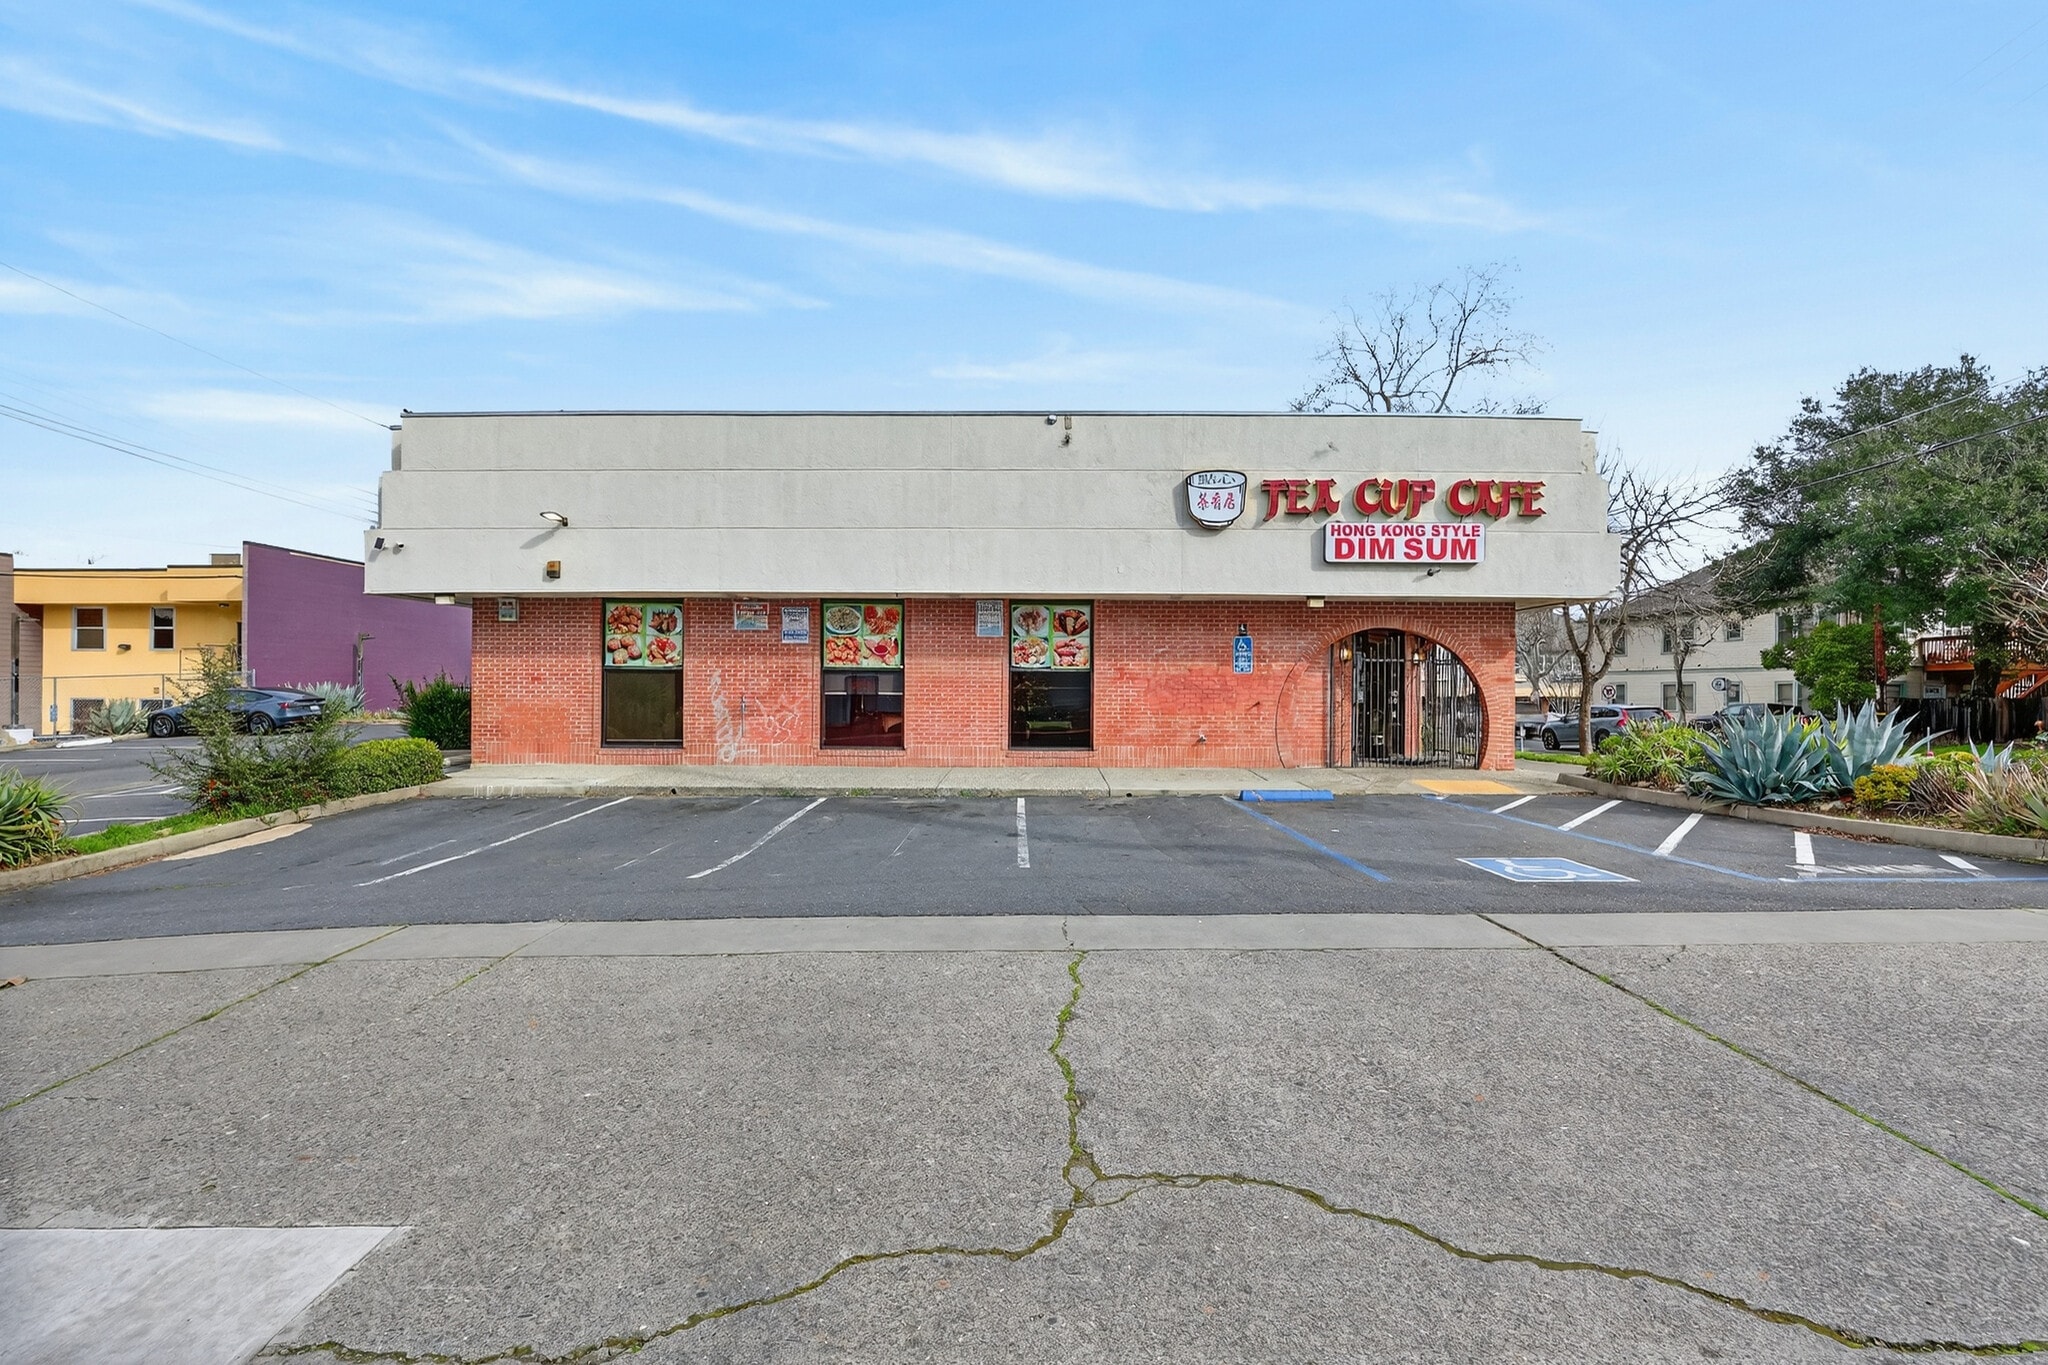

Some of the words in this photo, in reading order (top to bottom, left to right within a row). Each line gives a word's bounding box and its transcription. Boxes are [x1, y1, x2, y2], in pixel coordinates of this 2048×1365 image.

[1261, 478, 1340, 522] TEA
[1353, 477, 1436, 520] CUP
[1446, 478, 1547, 520] CAFE
[1330, 524, 1376, 537] HONG
[1381, 524, 1426, 537] KONG
[1431, 524, 1481, 537] STYLE
[1334, 538, 1395, 560] DIM
[1403, 537, 1477, 561] SUM
